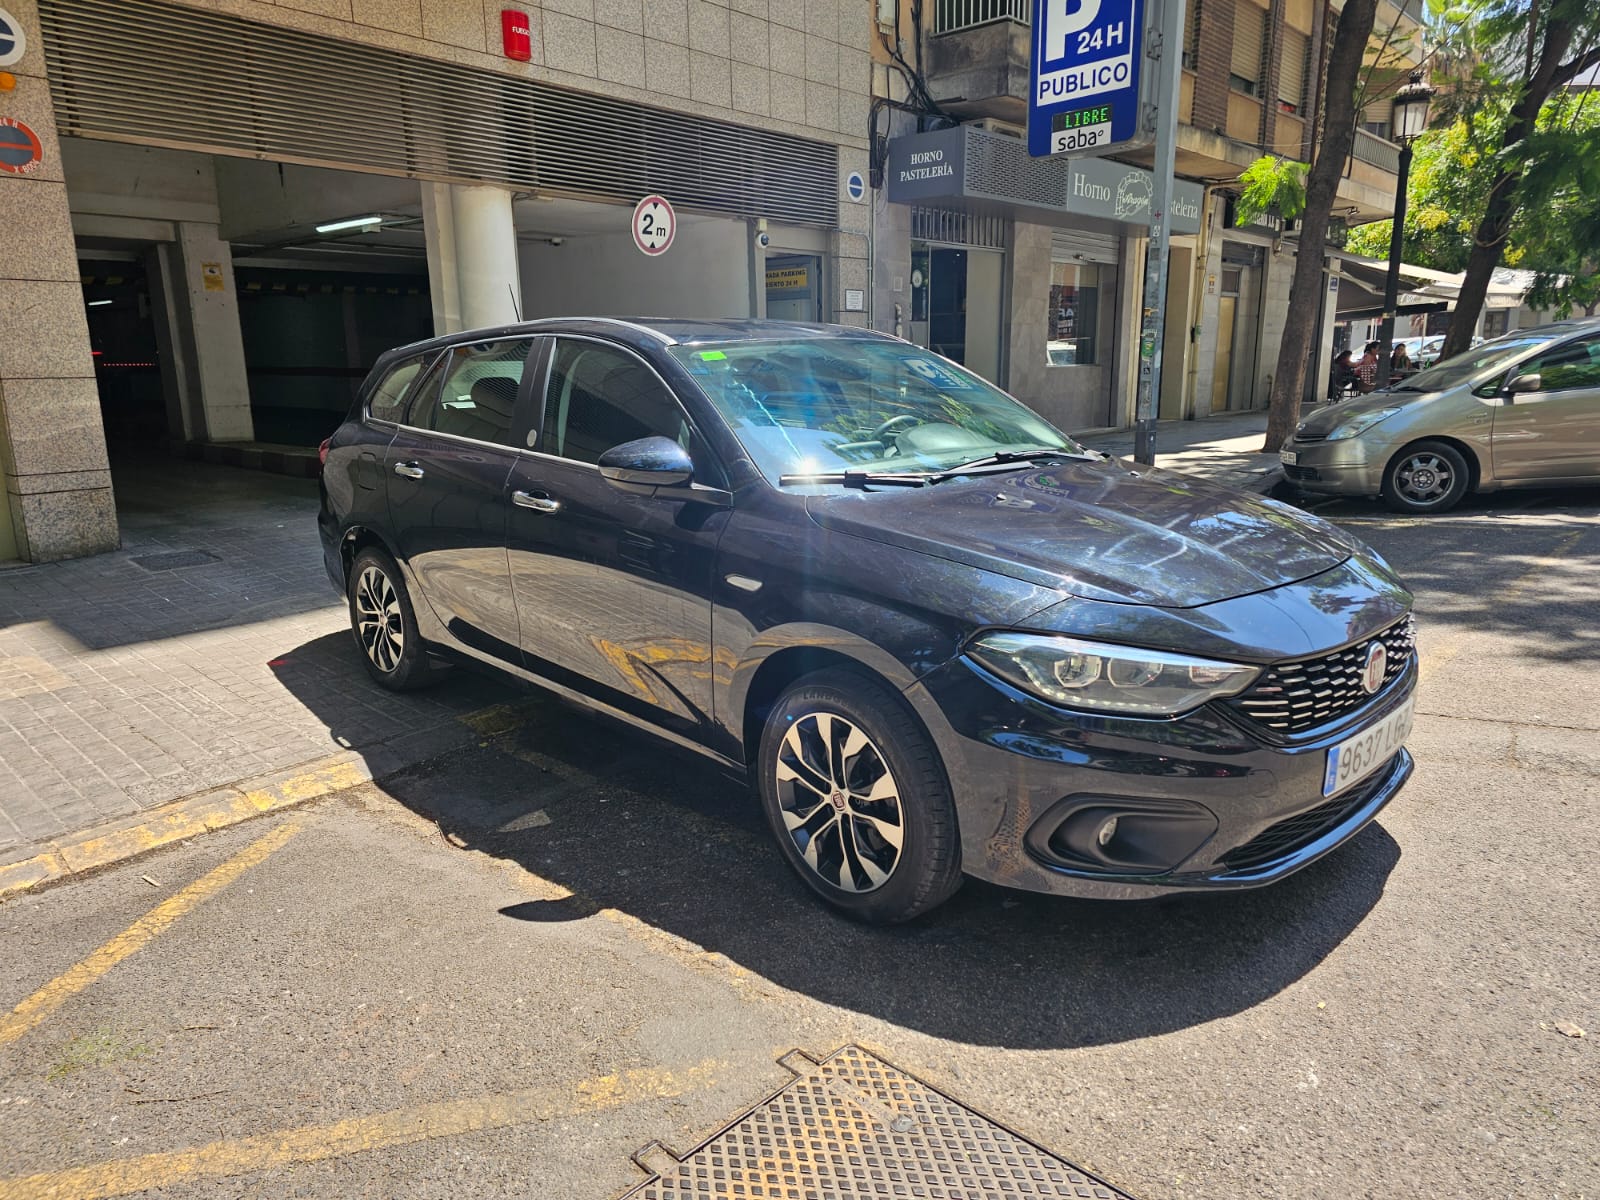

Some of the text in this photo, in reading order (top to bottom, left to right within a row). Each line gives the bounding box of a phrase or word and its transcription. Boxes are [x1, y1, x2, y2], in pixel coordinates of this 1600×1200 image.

[1046, 0, 1100, 62] P
[1077, 21, 1123, 55] 24 H
[1040, 62, 1128, 99] PUBLICO
[1065, 107, 1109, 128] LIBRE
[911, 150, 943, 165] HORNO
[900, 162, 953, 182] PASTELERÍA
[1073, 173, 1111, 201] Horno
[642, 213, 666, 237] 2 m
[1340, 727, 1384, 781] 9637
